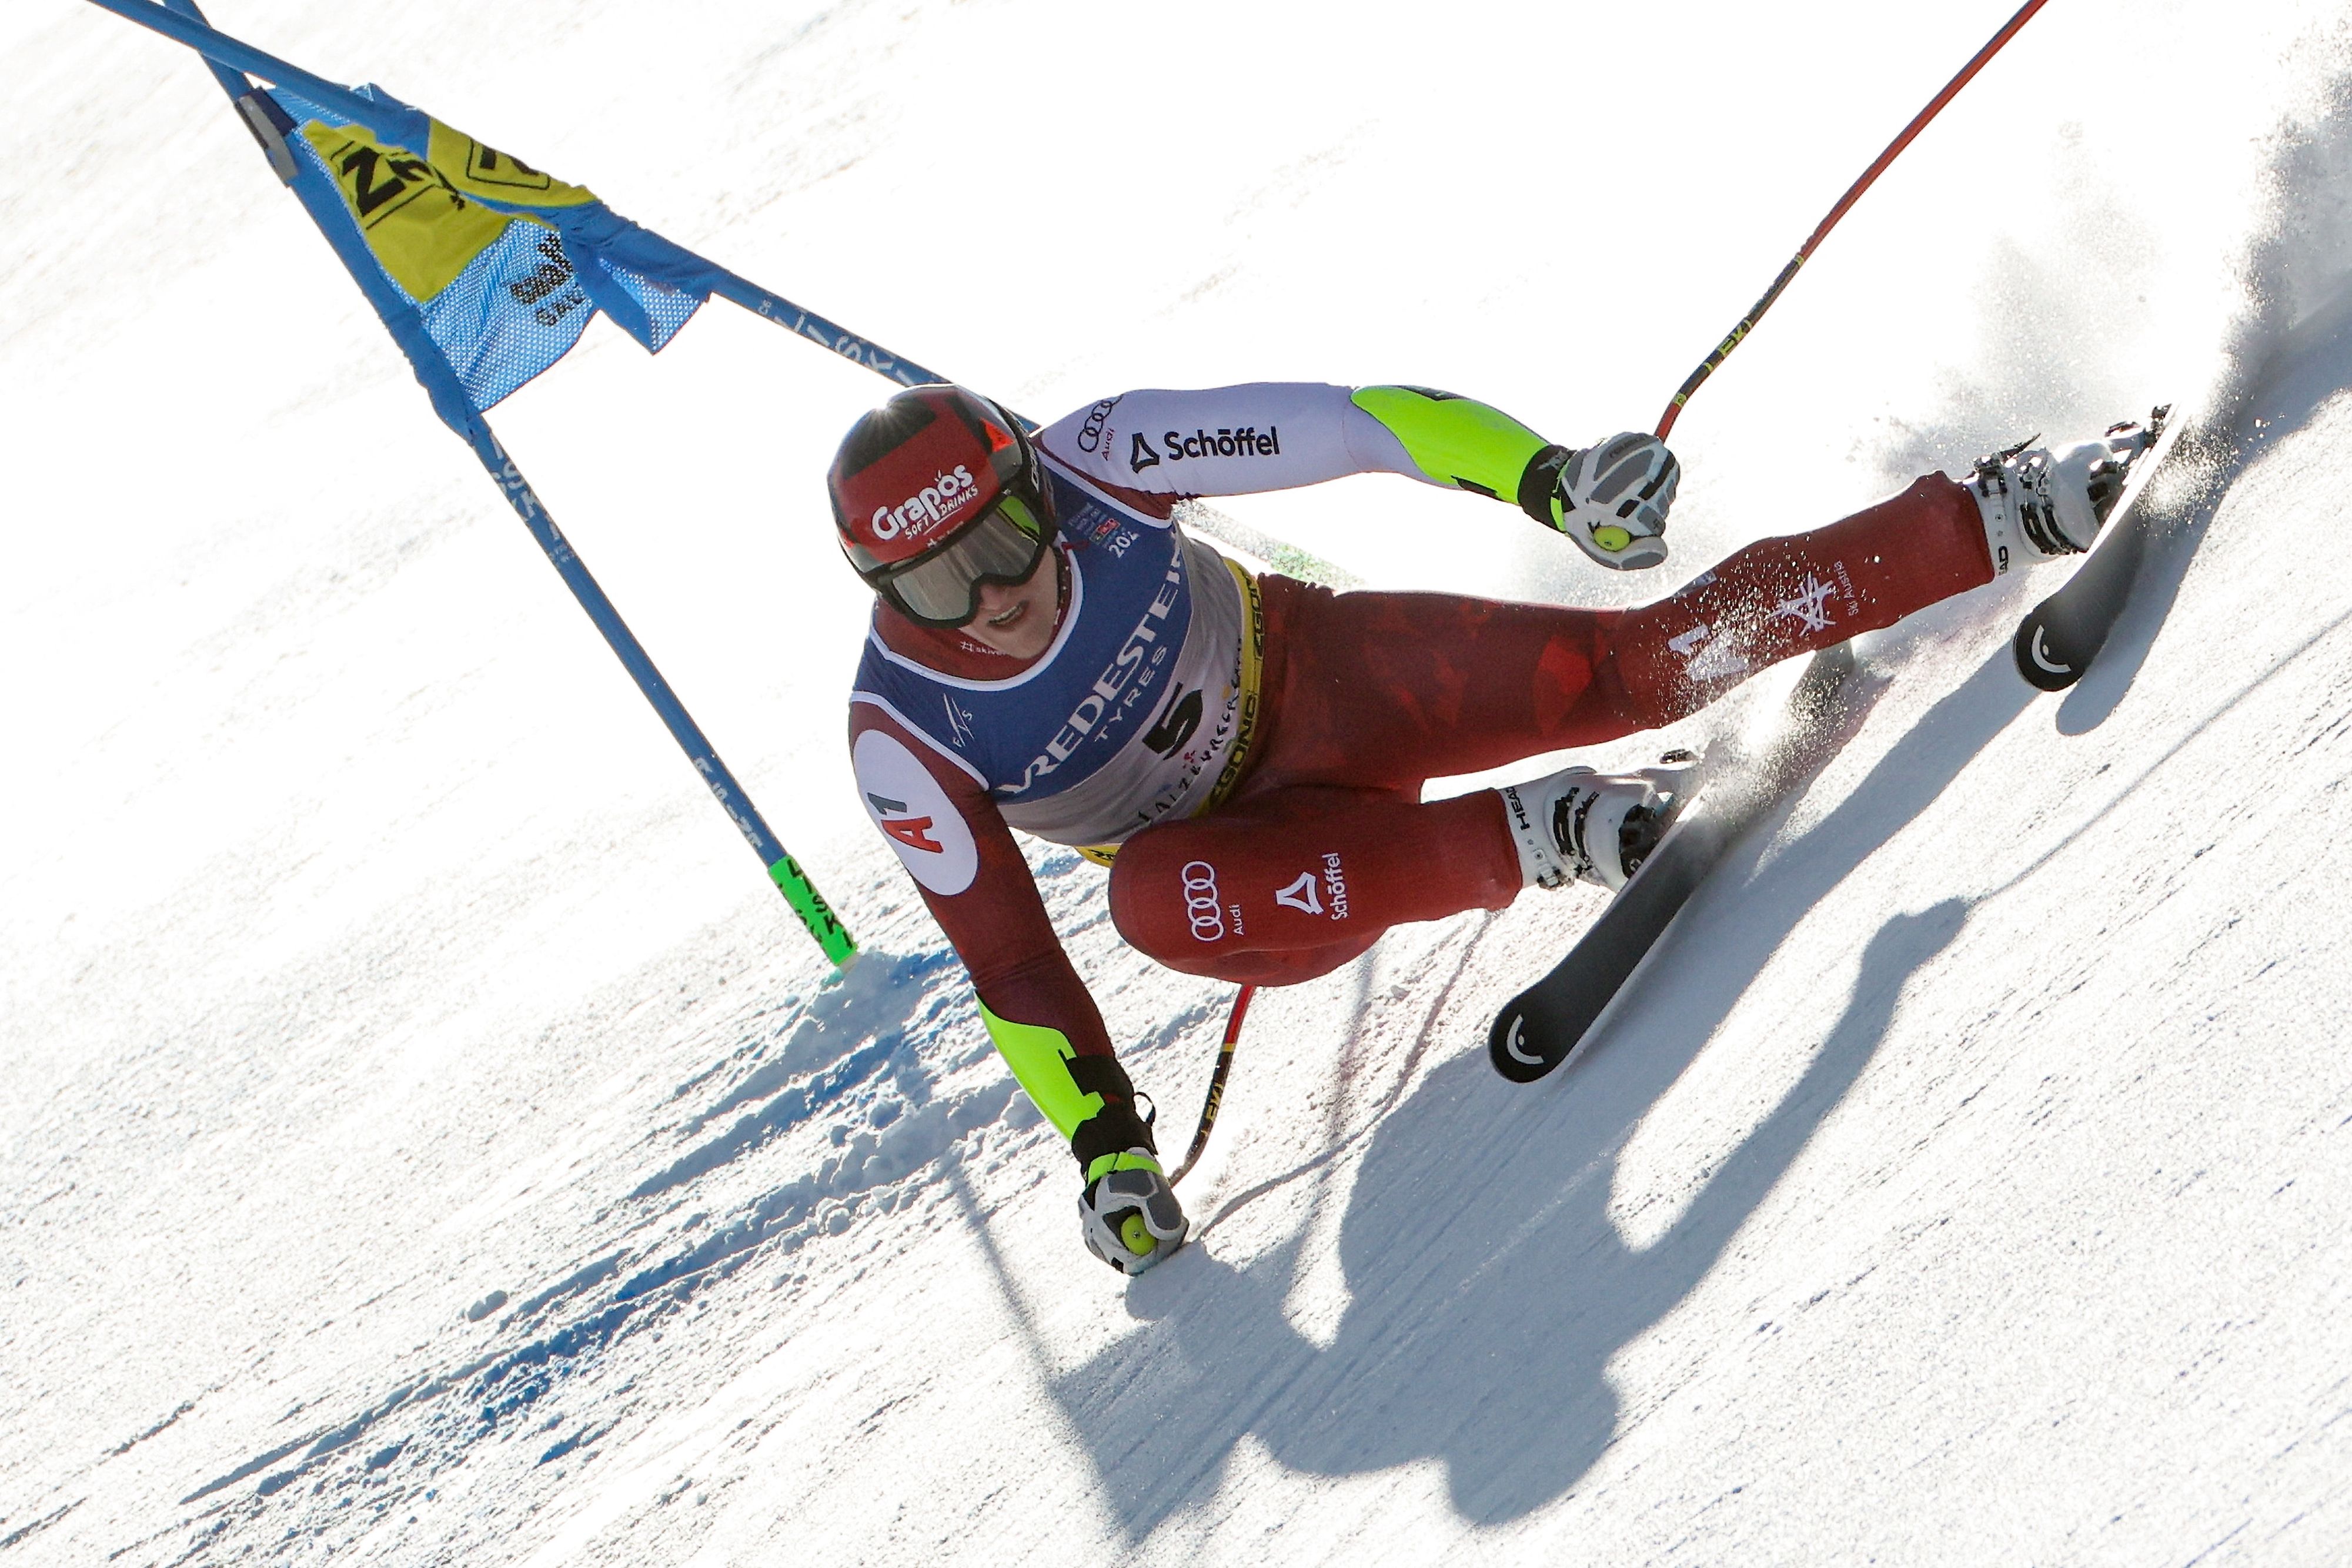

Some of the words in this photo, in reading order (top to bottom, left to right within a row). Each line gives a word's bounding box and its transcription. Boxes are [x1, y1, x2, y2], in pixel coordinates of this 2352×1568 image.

[1101, 428, 1116, 462] Audi
[871, 464, 973, 540] Grapos
[905, 514, 929, 540] SOFT
[938, 484, 978, 517] DRINKS
[1094, 646, 1167, 743] TYRES
[1142, 681, 1204, 761] 5
[1233, 903, 1244, 935] Audi
